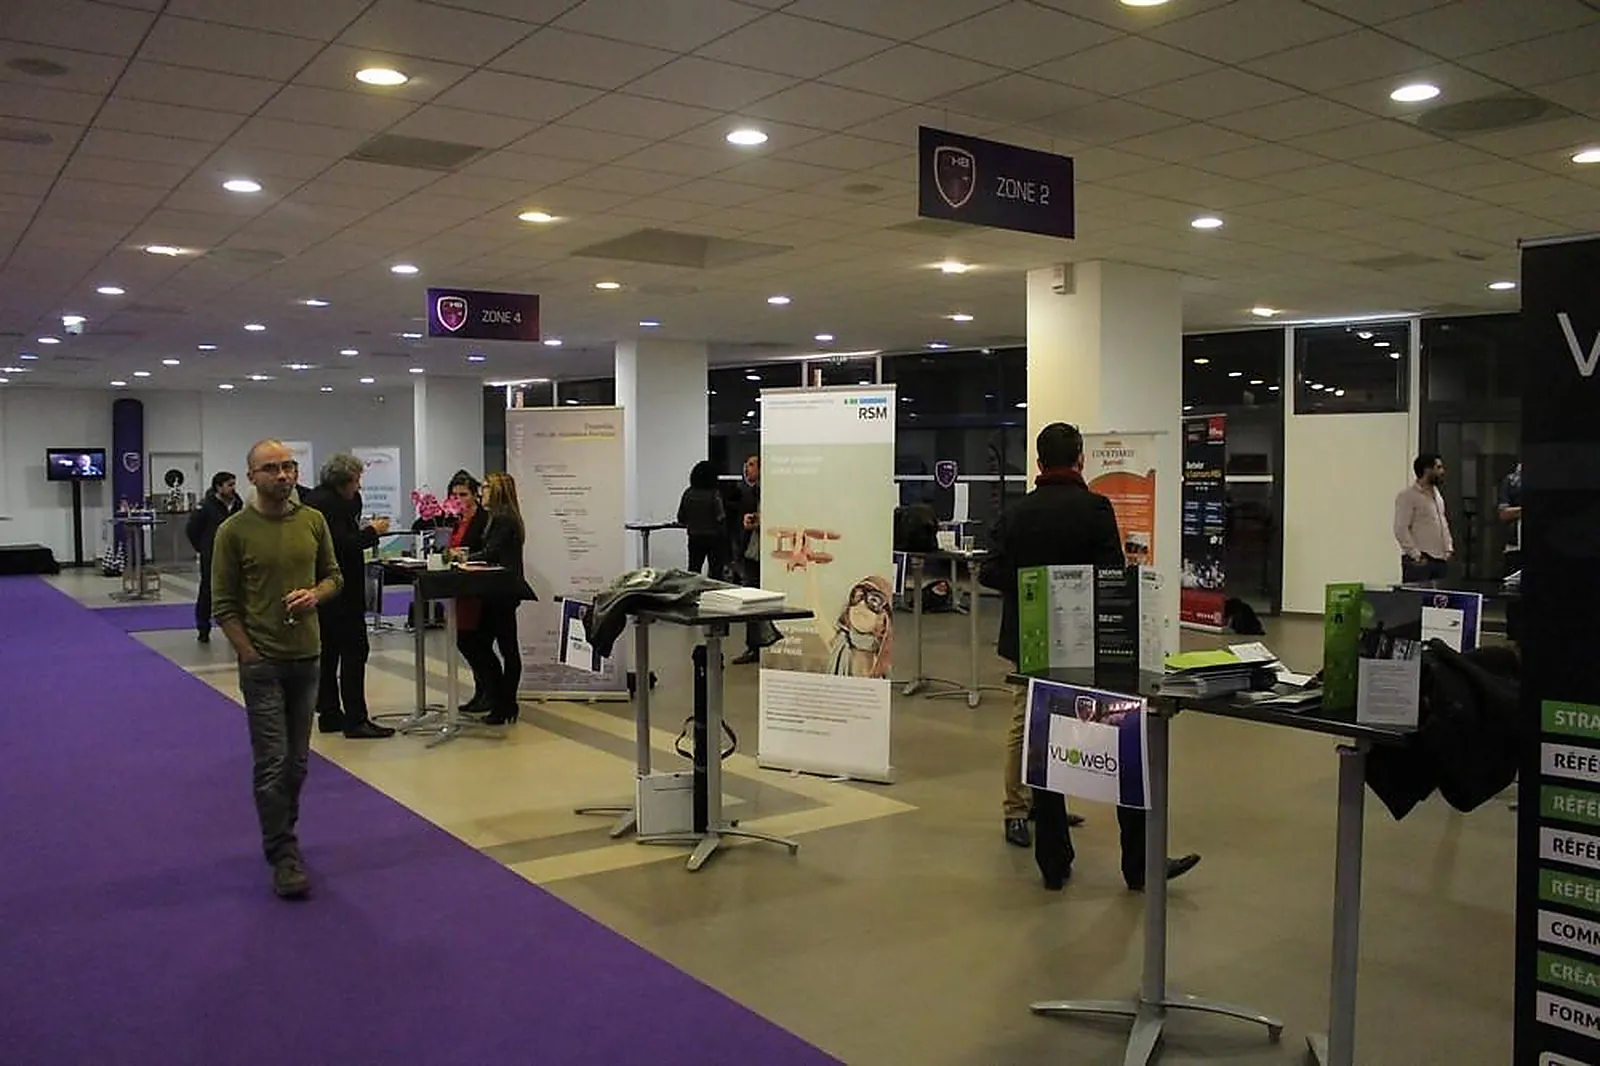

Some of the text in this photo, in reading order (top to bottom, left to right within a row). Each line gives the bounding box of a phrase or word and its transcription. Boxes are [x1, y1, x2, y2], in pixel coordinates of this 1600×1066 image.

[996, 177, 1050, 205] ZONE 2
[482, 310, 522, 323] ZONE 4
[858, 406, 888, 420] RSM
[1555, 709, 1600, 731] STRA
[1553, 794, 1600, 818] RÉFÉ
[1552, 836, 1600, 860] RÉFÉ
[1550, 962, 1600, 988] CRÉA
[1549, 1002, 1600, 1031] FORM
